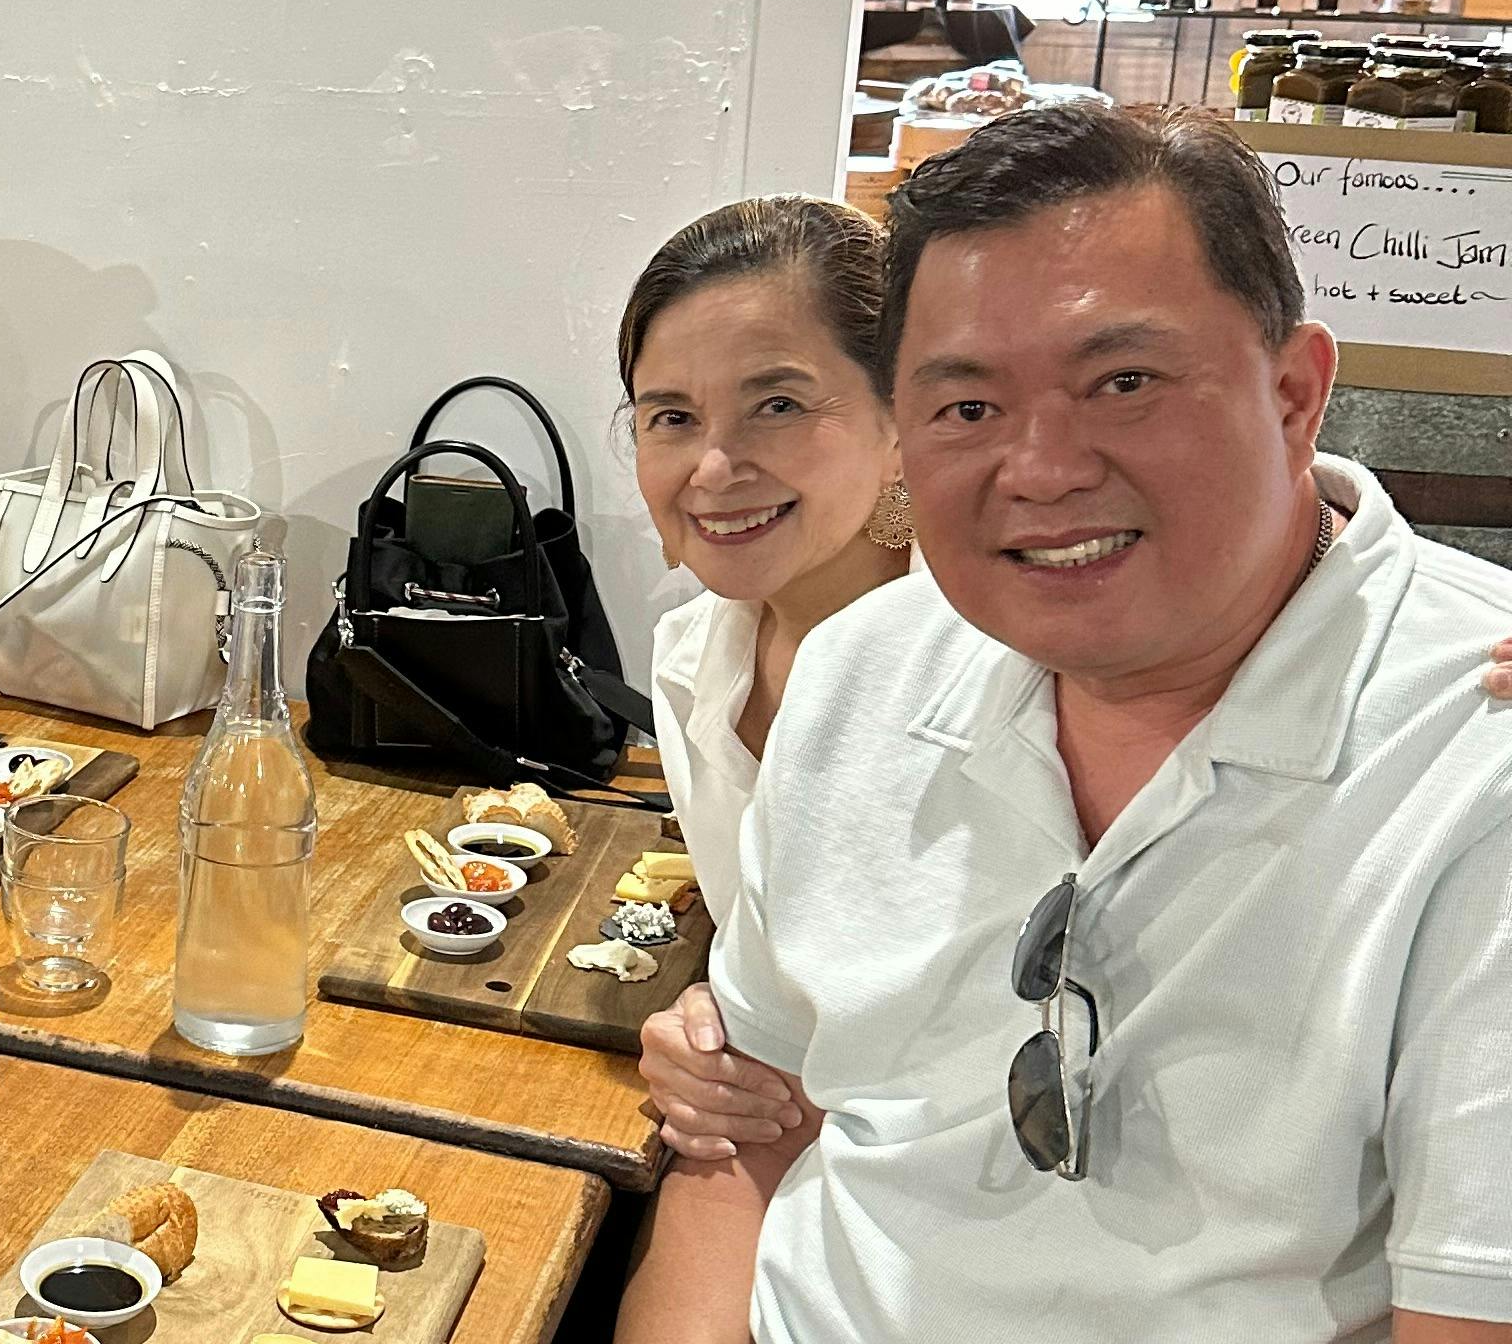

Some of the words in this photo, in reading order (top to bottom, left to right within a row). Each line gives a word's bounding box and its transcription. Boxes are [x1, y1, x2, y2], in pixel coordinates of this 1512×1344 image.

[1275, 161, 1331, 186] Our
[1288, 224, 1340, 249] reen
[1350, 223, 1428, 260] Chilli
[1436, 230, 1506, 269] Jam
[1314, 273, 1357, 299] hot
[1389, 284, 1467, 305] sweet
